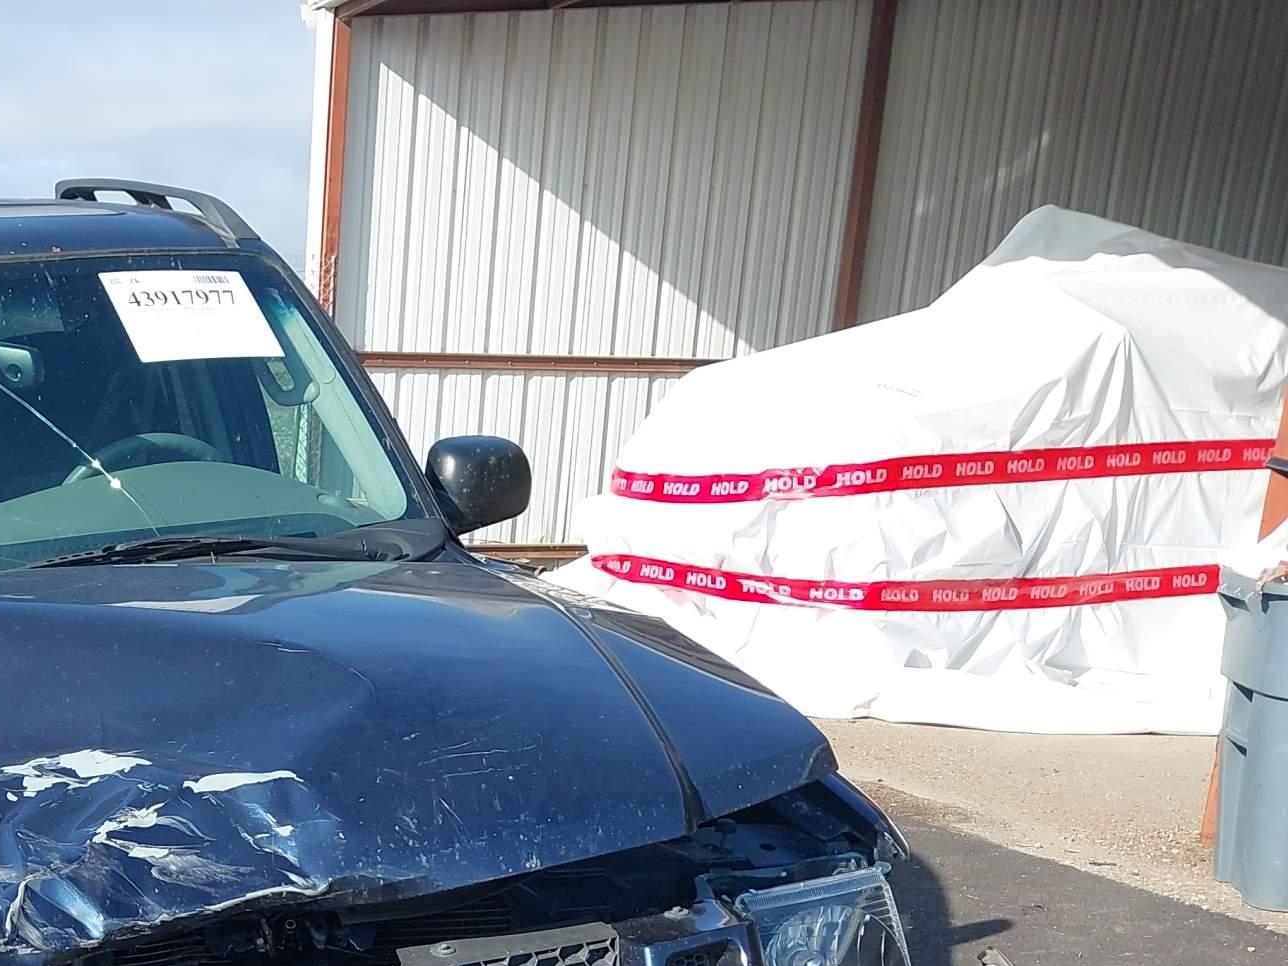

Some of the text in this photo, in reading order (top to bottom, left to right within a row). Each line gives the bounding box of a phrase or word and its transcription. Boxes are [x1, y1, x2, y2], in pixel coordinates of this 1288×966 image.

[128, 289, 236, 307] 43917977
[631, 480, 654, 493] HOLD
[663, 481, 701, 496] HOLD
[711, 481, 749, 495] HOLD
[763, 475, 817, 492] HOLD
[834, 469, 887, 488] HOLD
[900, 464, 942, 480] HOLD
[956, 461, 994, 476] HOLD
[1007, 458, 1044, 473] HOLD
[1057, 456, 1094, 471] HOLD
[1106, 452, 1141, 467] HOLD
[1152, 450, 1186, 465] HOLD
[1197, 448, 1231, 462] HOLD
[640, 564, 675, 581] HOLD
[686, 572, 727, 589] HOLD
[809, 587, 865, 601] HOLD
[881, 588, 919, 602] HOLD
[933, 588, 969, 602] HOLD
[981, 587, 1018, 601] HOLD
[1030, 584, 1068, 599] HOLD
[1079, 581, 1114, 596] HOLD
[1125, 577, 1160, 592] HOLD
[1173, 573, 1207, 588] HOLD
